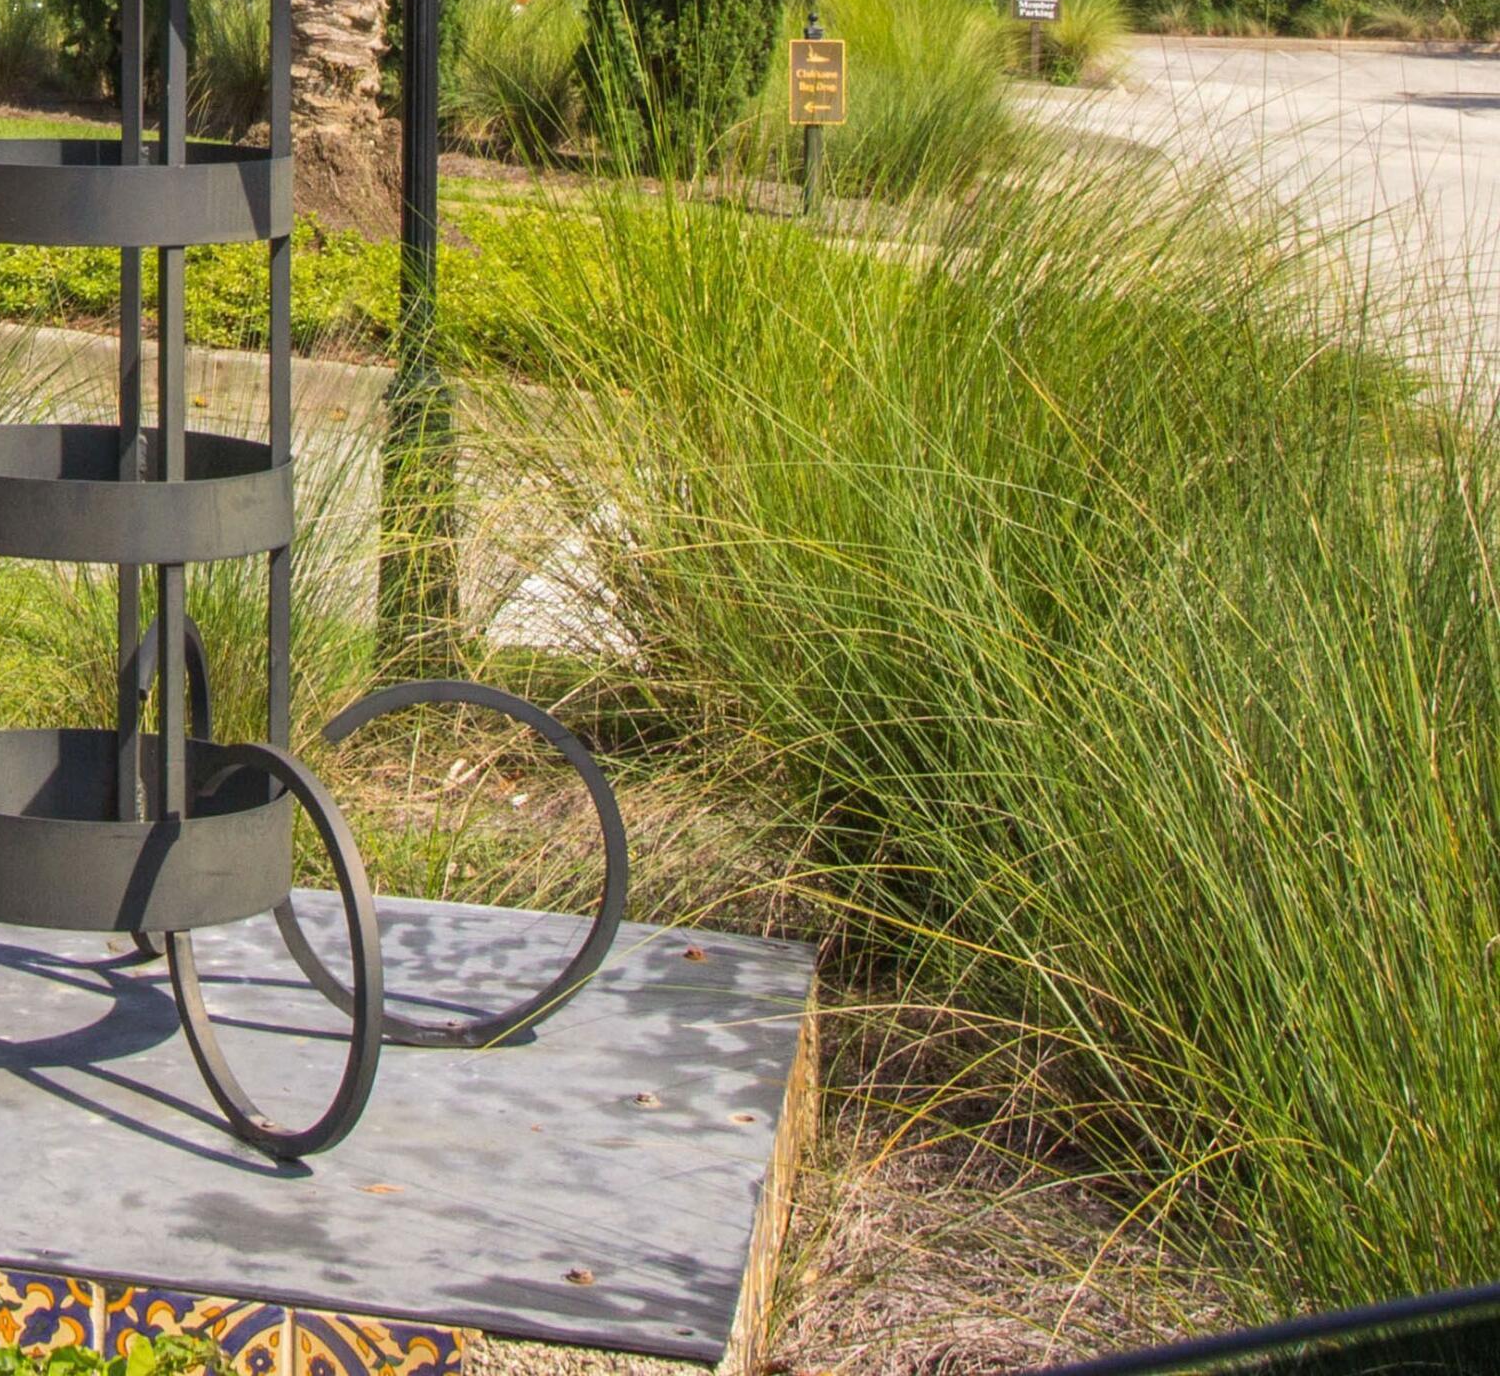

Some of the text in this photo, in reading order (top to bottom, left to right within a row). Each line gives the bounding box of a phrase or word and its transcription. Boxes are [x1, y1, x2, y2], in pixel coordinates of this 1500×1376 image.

[1018, 0, 1056, 9] Member
[1019, 8, 1055, 19] Parking
[799, 81, 837, 93] Bag Drop
